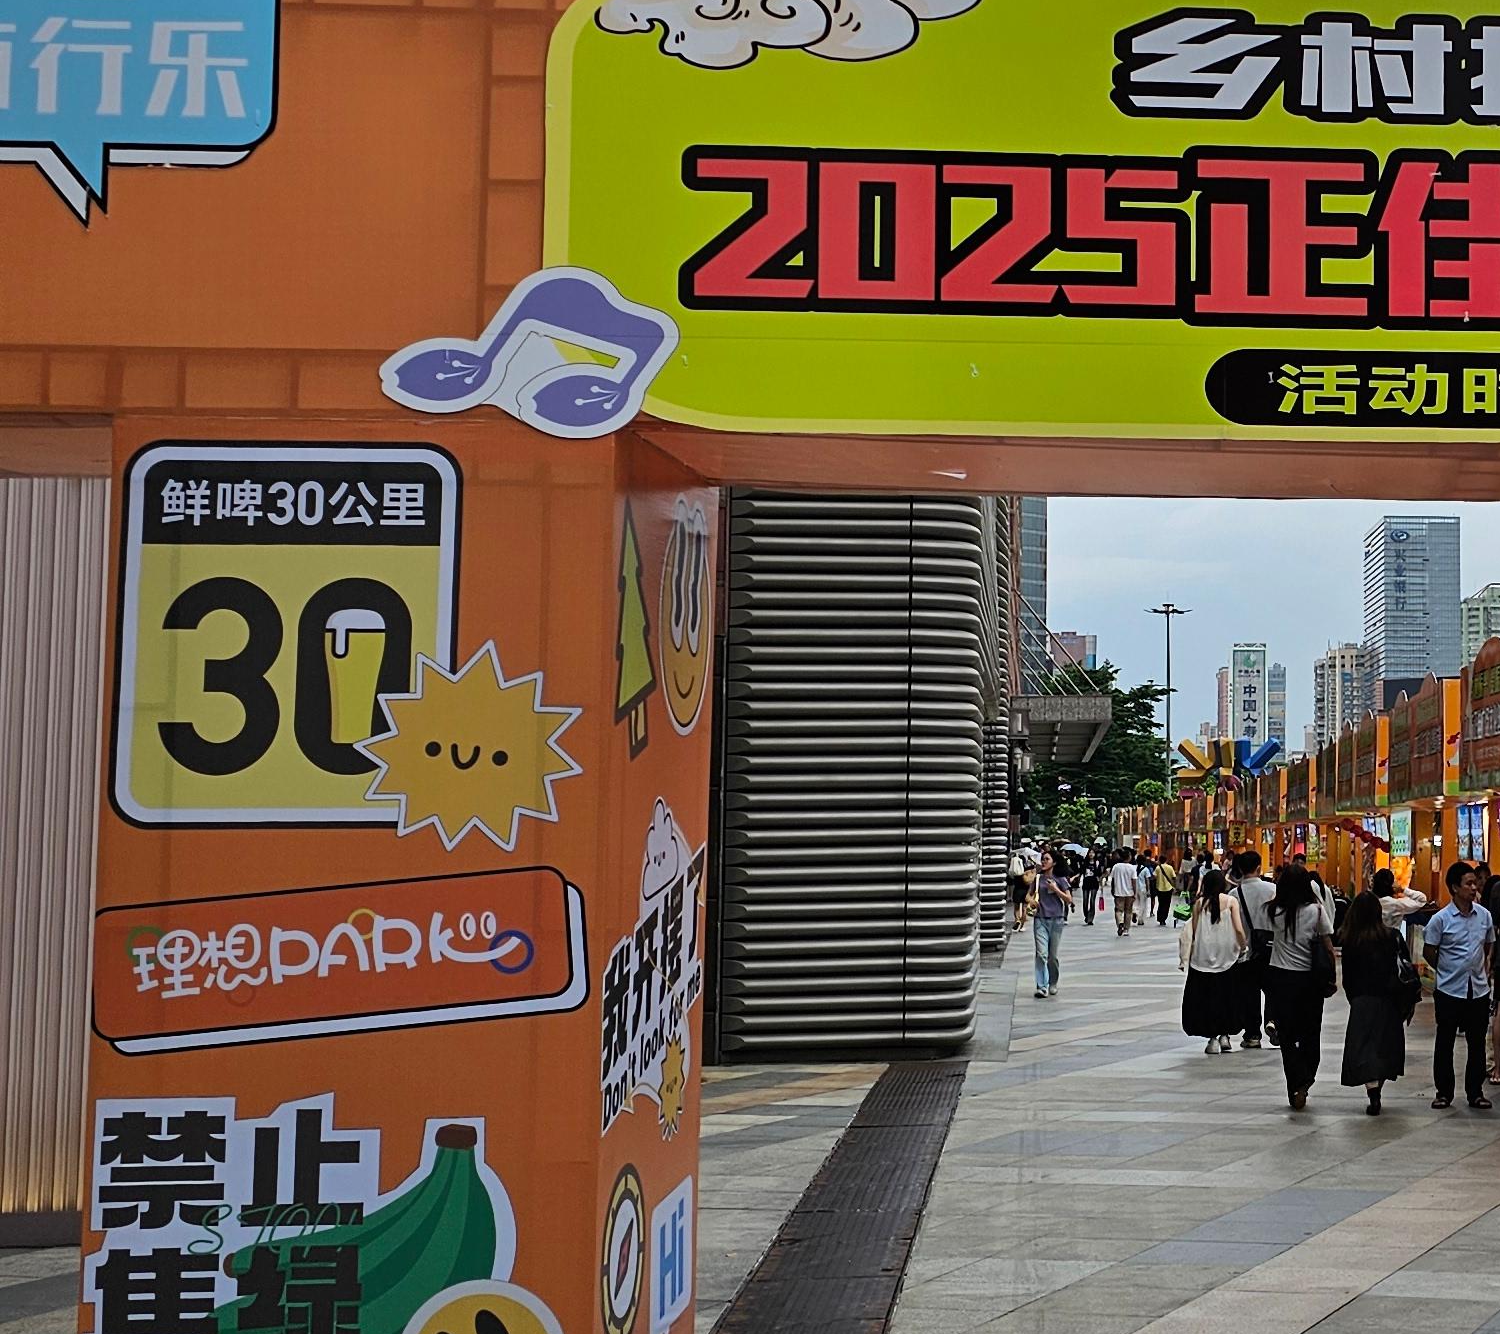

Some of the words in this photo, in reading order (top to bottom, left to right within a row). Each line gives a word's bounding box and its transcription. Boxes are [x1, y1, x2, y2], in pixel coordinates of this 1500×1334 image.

[0, 18, 249, 119] 行乐
[160, 480, 427, 528] 鲜啤30公里
[158, 576, 413, 776] 30
[1242, 683, 1258, 738] 中国人寿
[98, 1108, 365, 1230] 禁止
[657, 1198, 685, 1320] Hi
